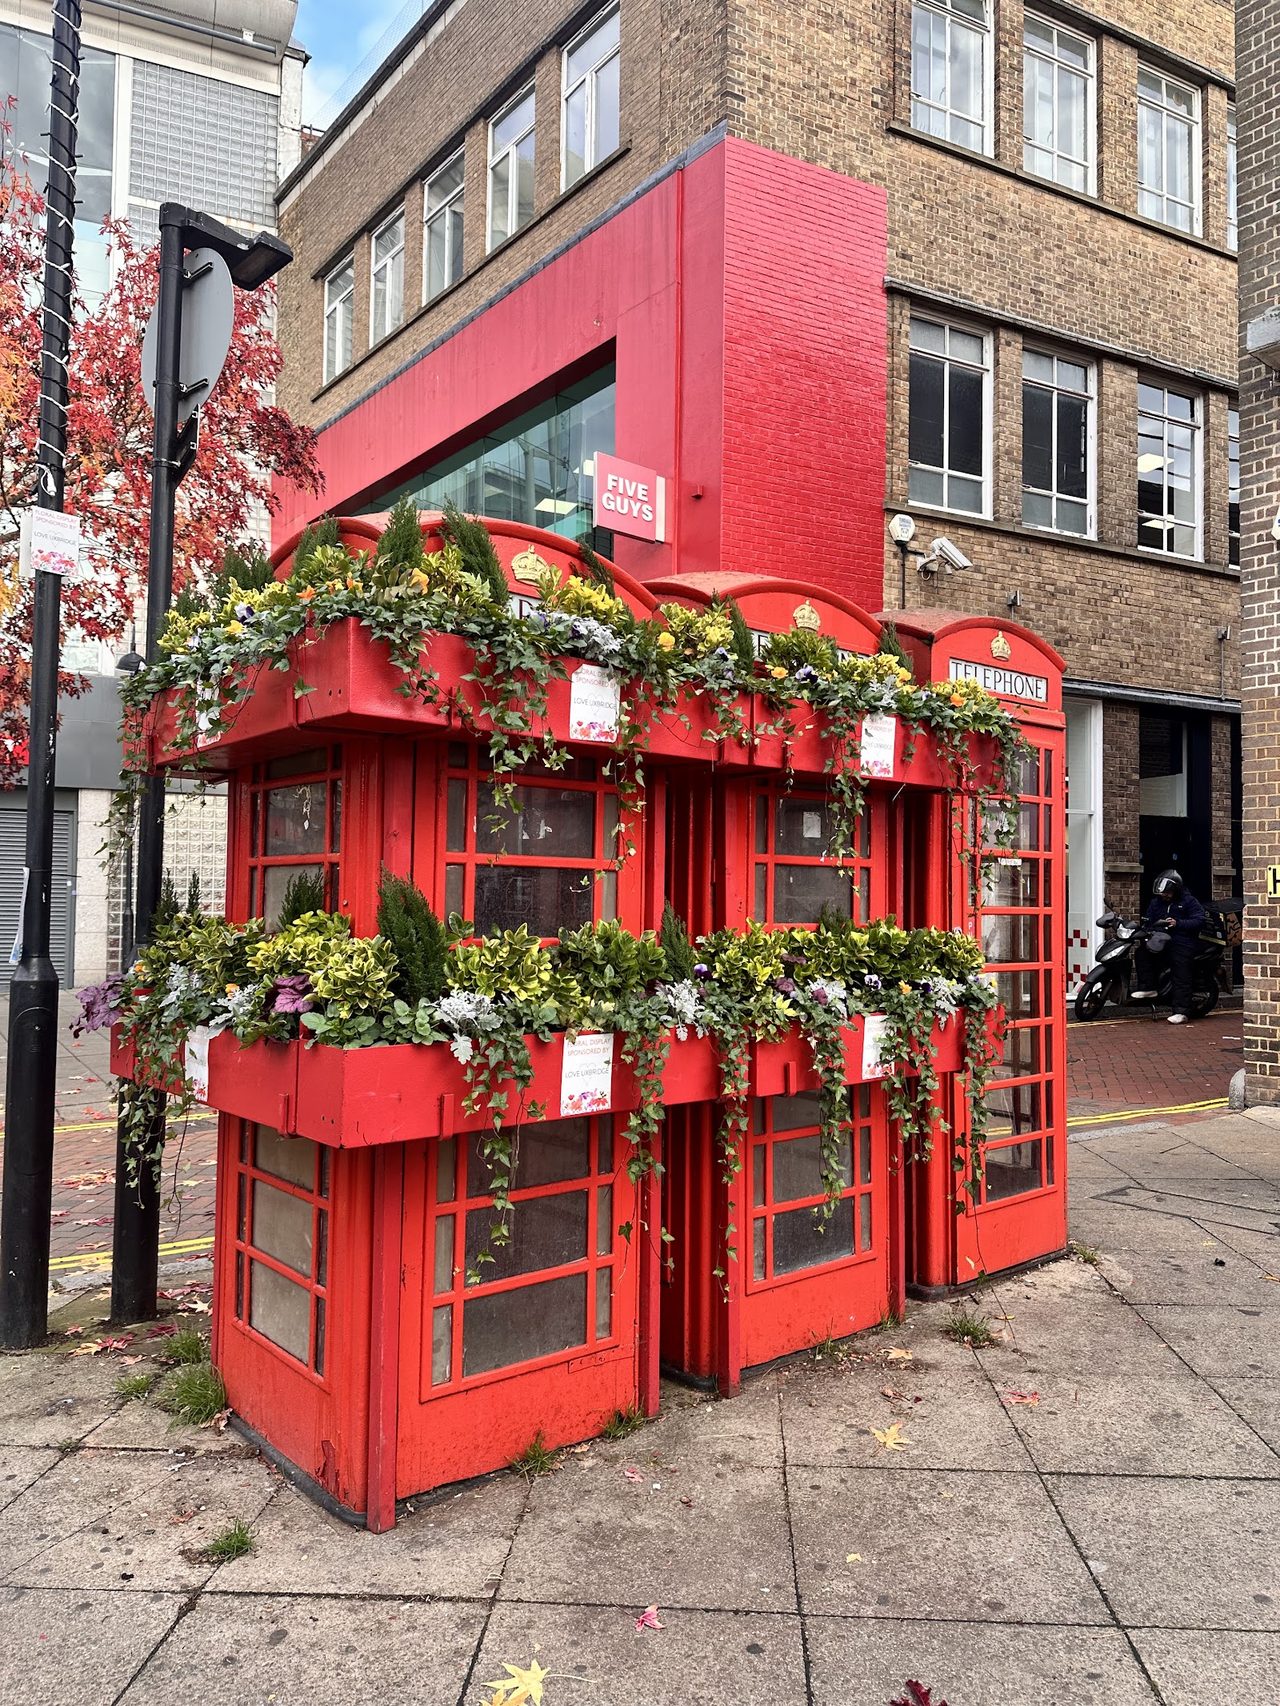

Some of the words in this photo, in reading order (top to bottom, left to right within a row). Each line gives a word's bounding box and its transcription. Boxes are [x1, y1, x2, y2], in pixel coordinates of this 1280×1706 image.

[608, 473, 649, 502] FIVE
[601, 492, 654, 522] GUYS
[34, 530, 48, 539] LOVE
[573, 697, 588, 706] LOVE
[567, 1047, 601, 1057] SPONSORED
[565, 1070, 580, 1079] LOVE
[581, 1067, 609, 1077] UXBRIDGE
